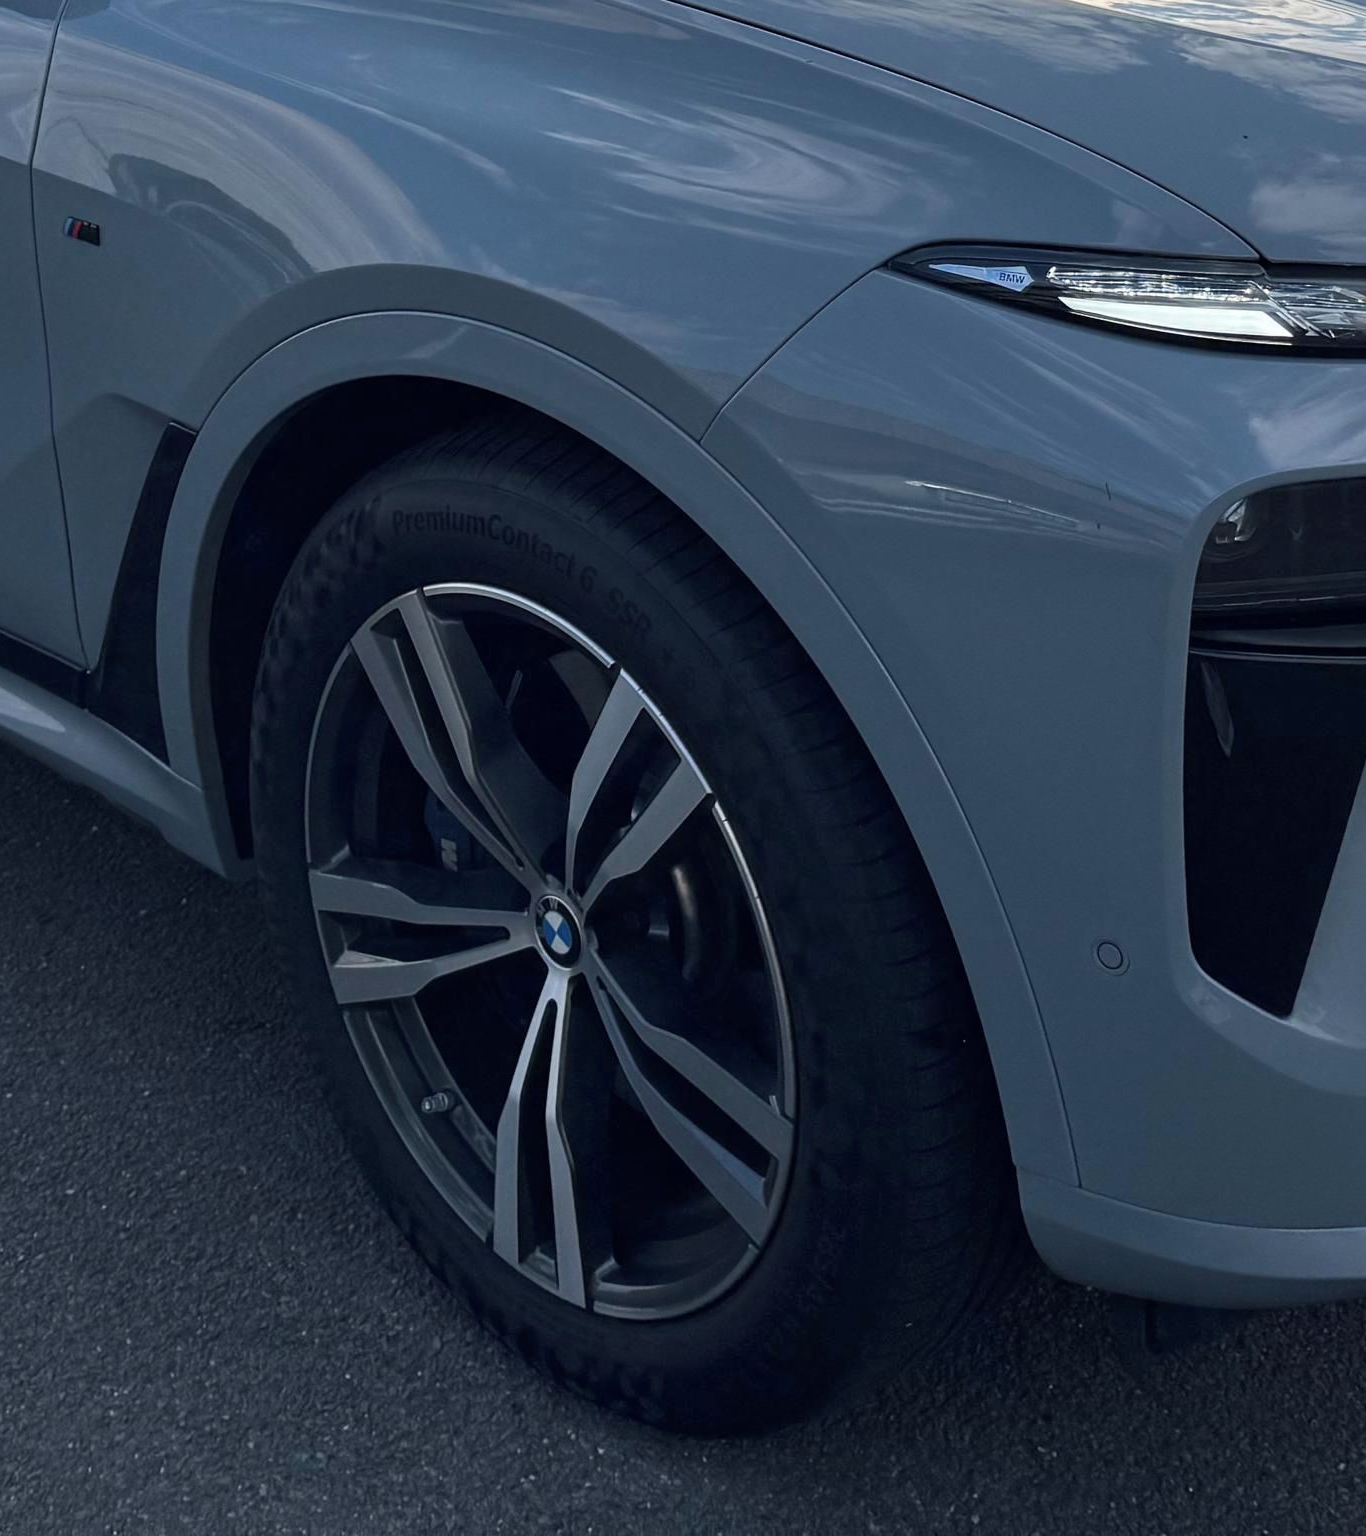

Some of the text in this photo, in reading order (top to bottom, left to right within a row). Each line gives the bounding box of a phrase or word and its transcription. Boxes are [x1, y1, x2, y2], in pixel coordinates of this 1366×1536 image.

[999, 272, 1026, 284] BMW
[391, 504, 575, 577] PremiumContact
[579, 565, 599, 593] 6
